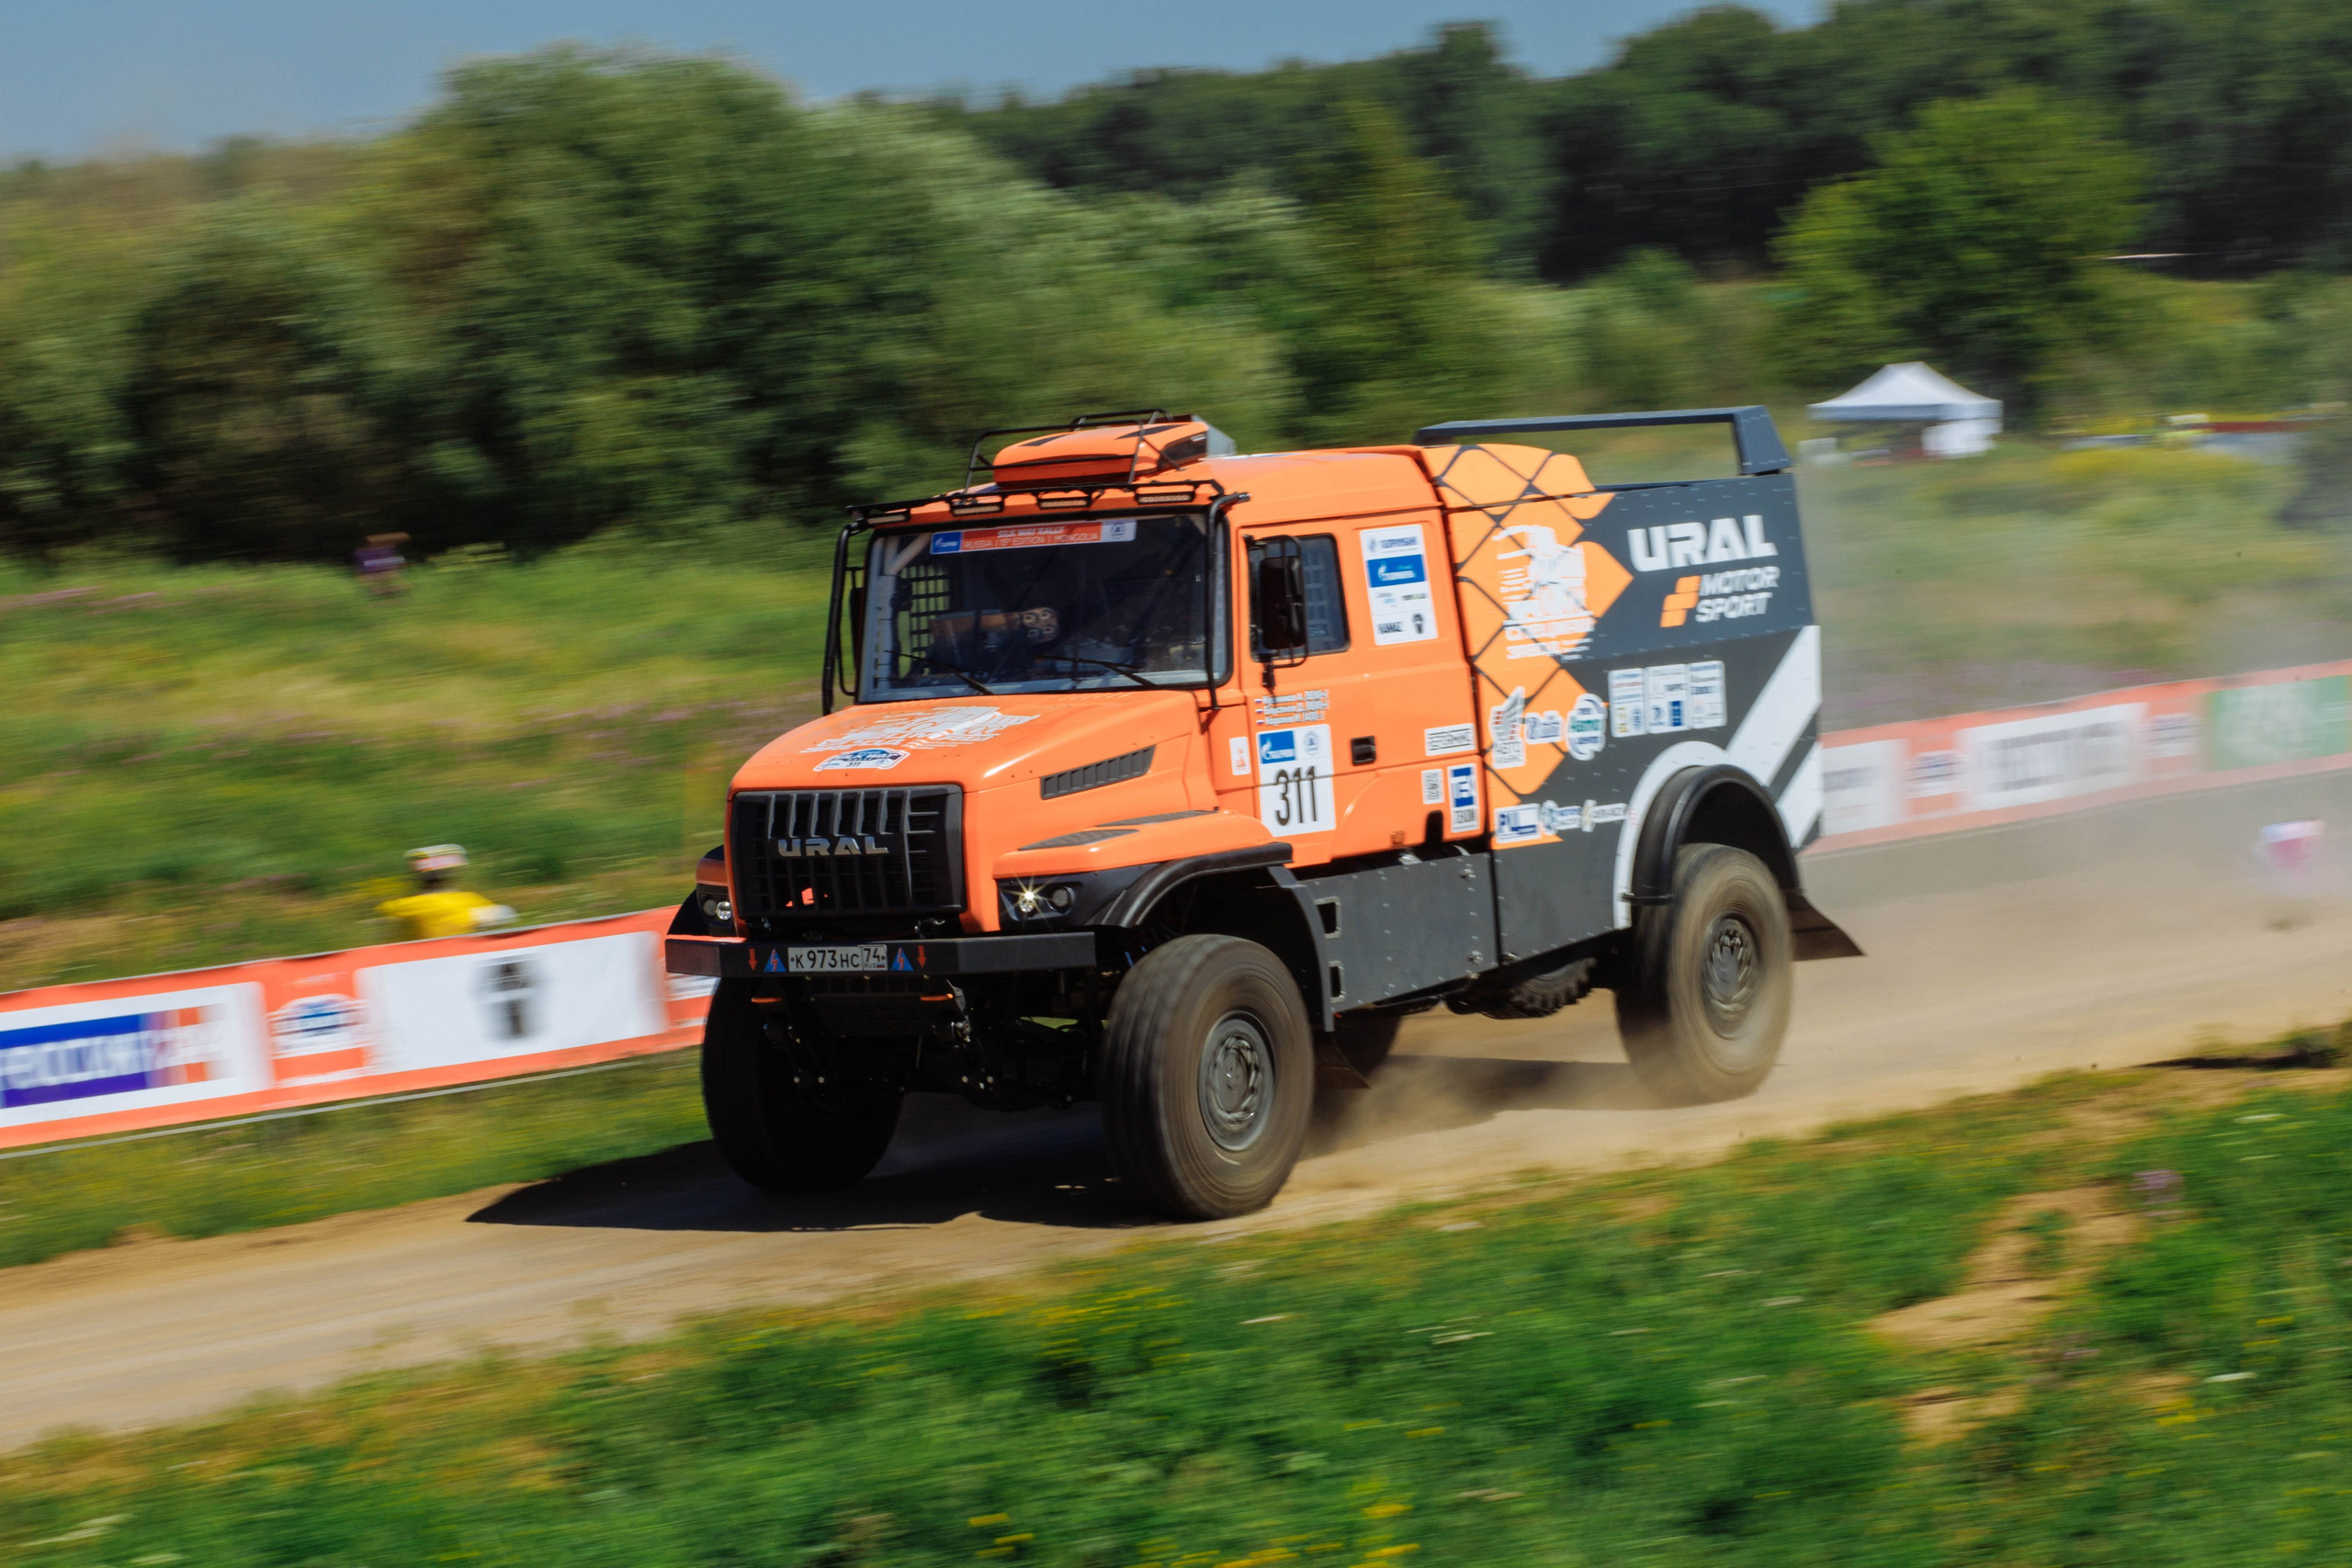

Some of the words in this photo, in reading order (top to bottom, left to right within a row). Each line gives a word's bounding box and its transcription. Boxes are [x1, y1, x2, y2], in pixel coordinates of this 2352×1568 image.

[1627, 514, 1779, 572] URAL
[1700, 566, 1781, 596] MOTOR
[1695, 592, 1774, 623] SPORT
[1275, 765, 1317, 827] 311
[778, 837, 889, 857] URAL
[864, 948, 880, 963] 74
